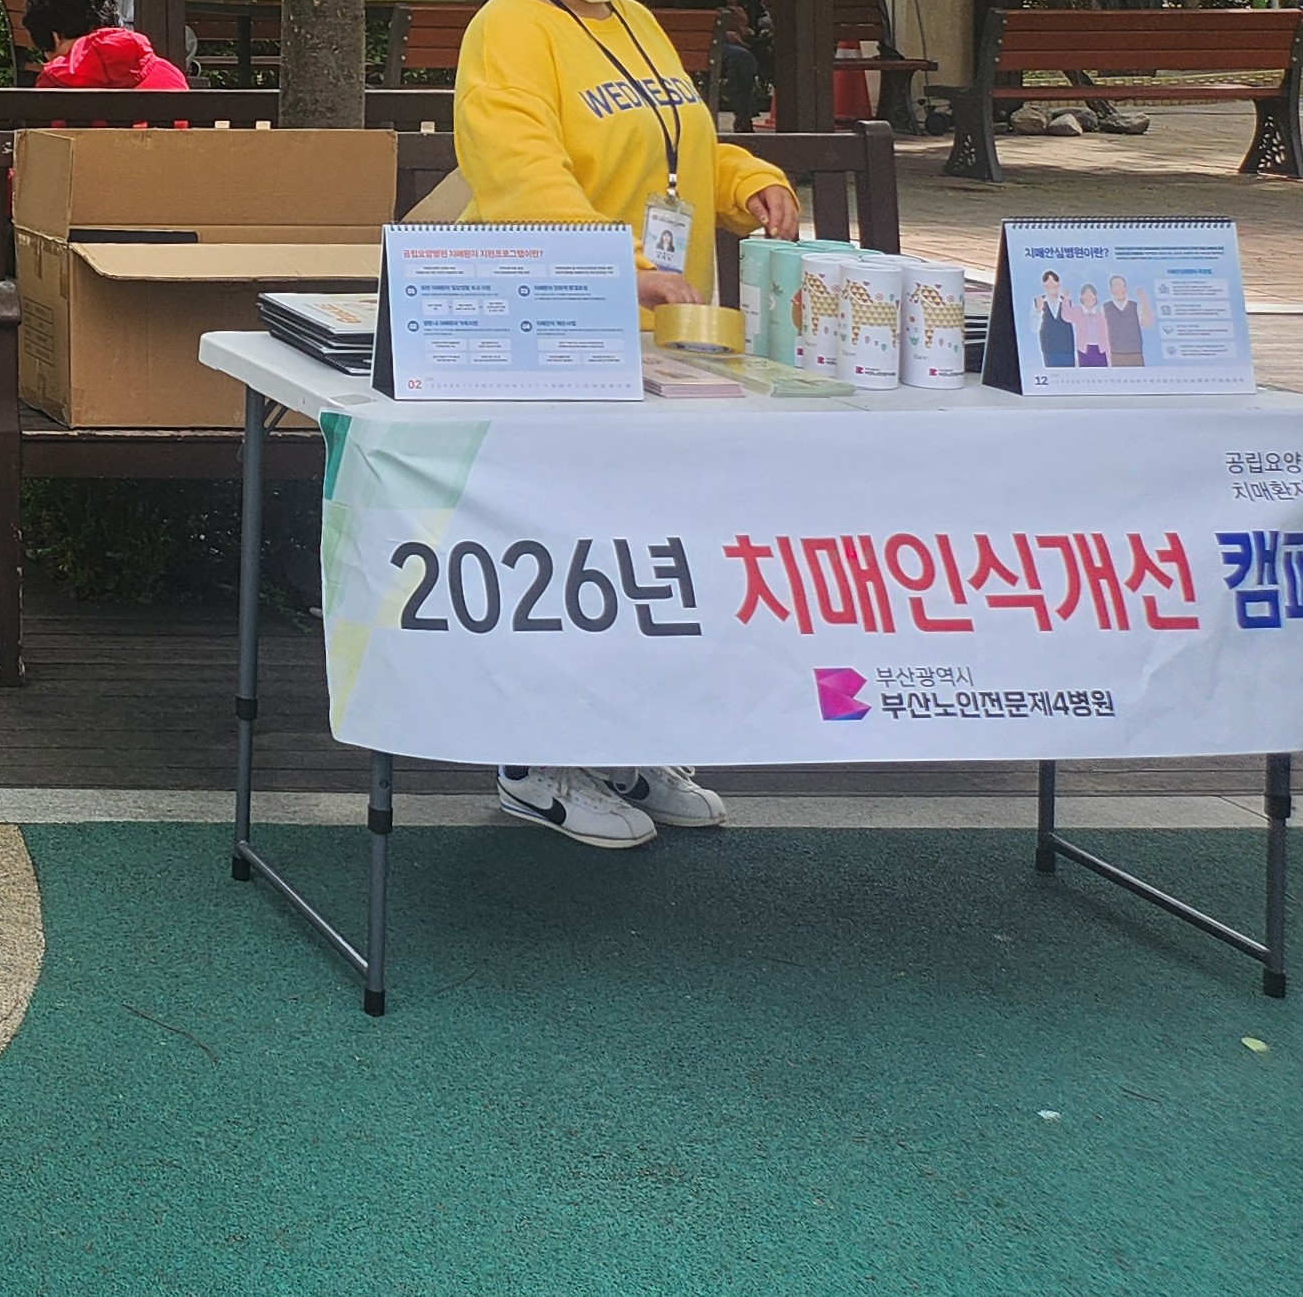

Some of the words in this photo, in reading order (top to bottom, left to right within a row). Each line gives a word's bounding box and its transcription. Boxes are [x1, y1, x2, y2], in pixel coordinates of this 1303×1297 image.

[1024, 246, 1109, 259] 치매안심병원이란?
[407, 379, 422, 390] 02
[1034, 376, 1048, 386] 12
[390, 536, 702, 636] 2026년
[722, 532, 1199, 634] 치매인식개선
[875, 666, 975, 688] 부산광역시
[880, 689, 1115, 720] 부산노인전문제4병원
